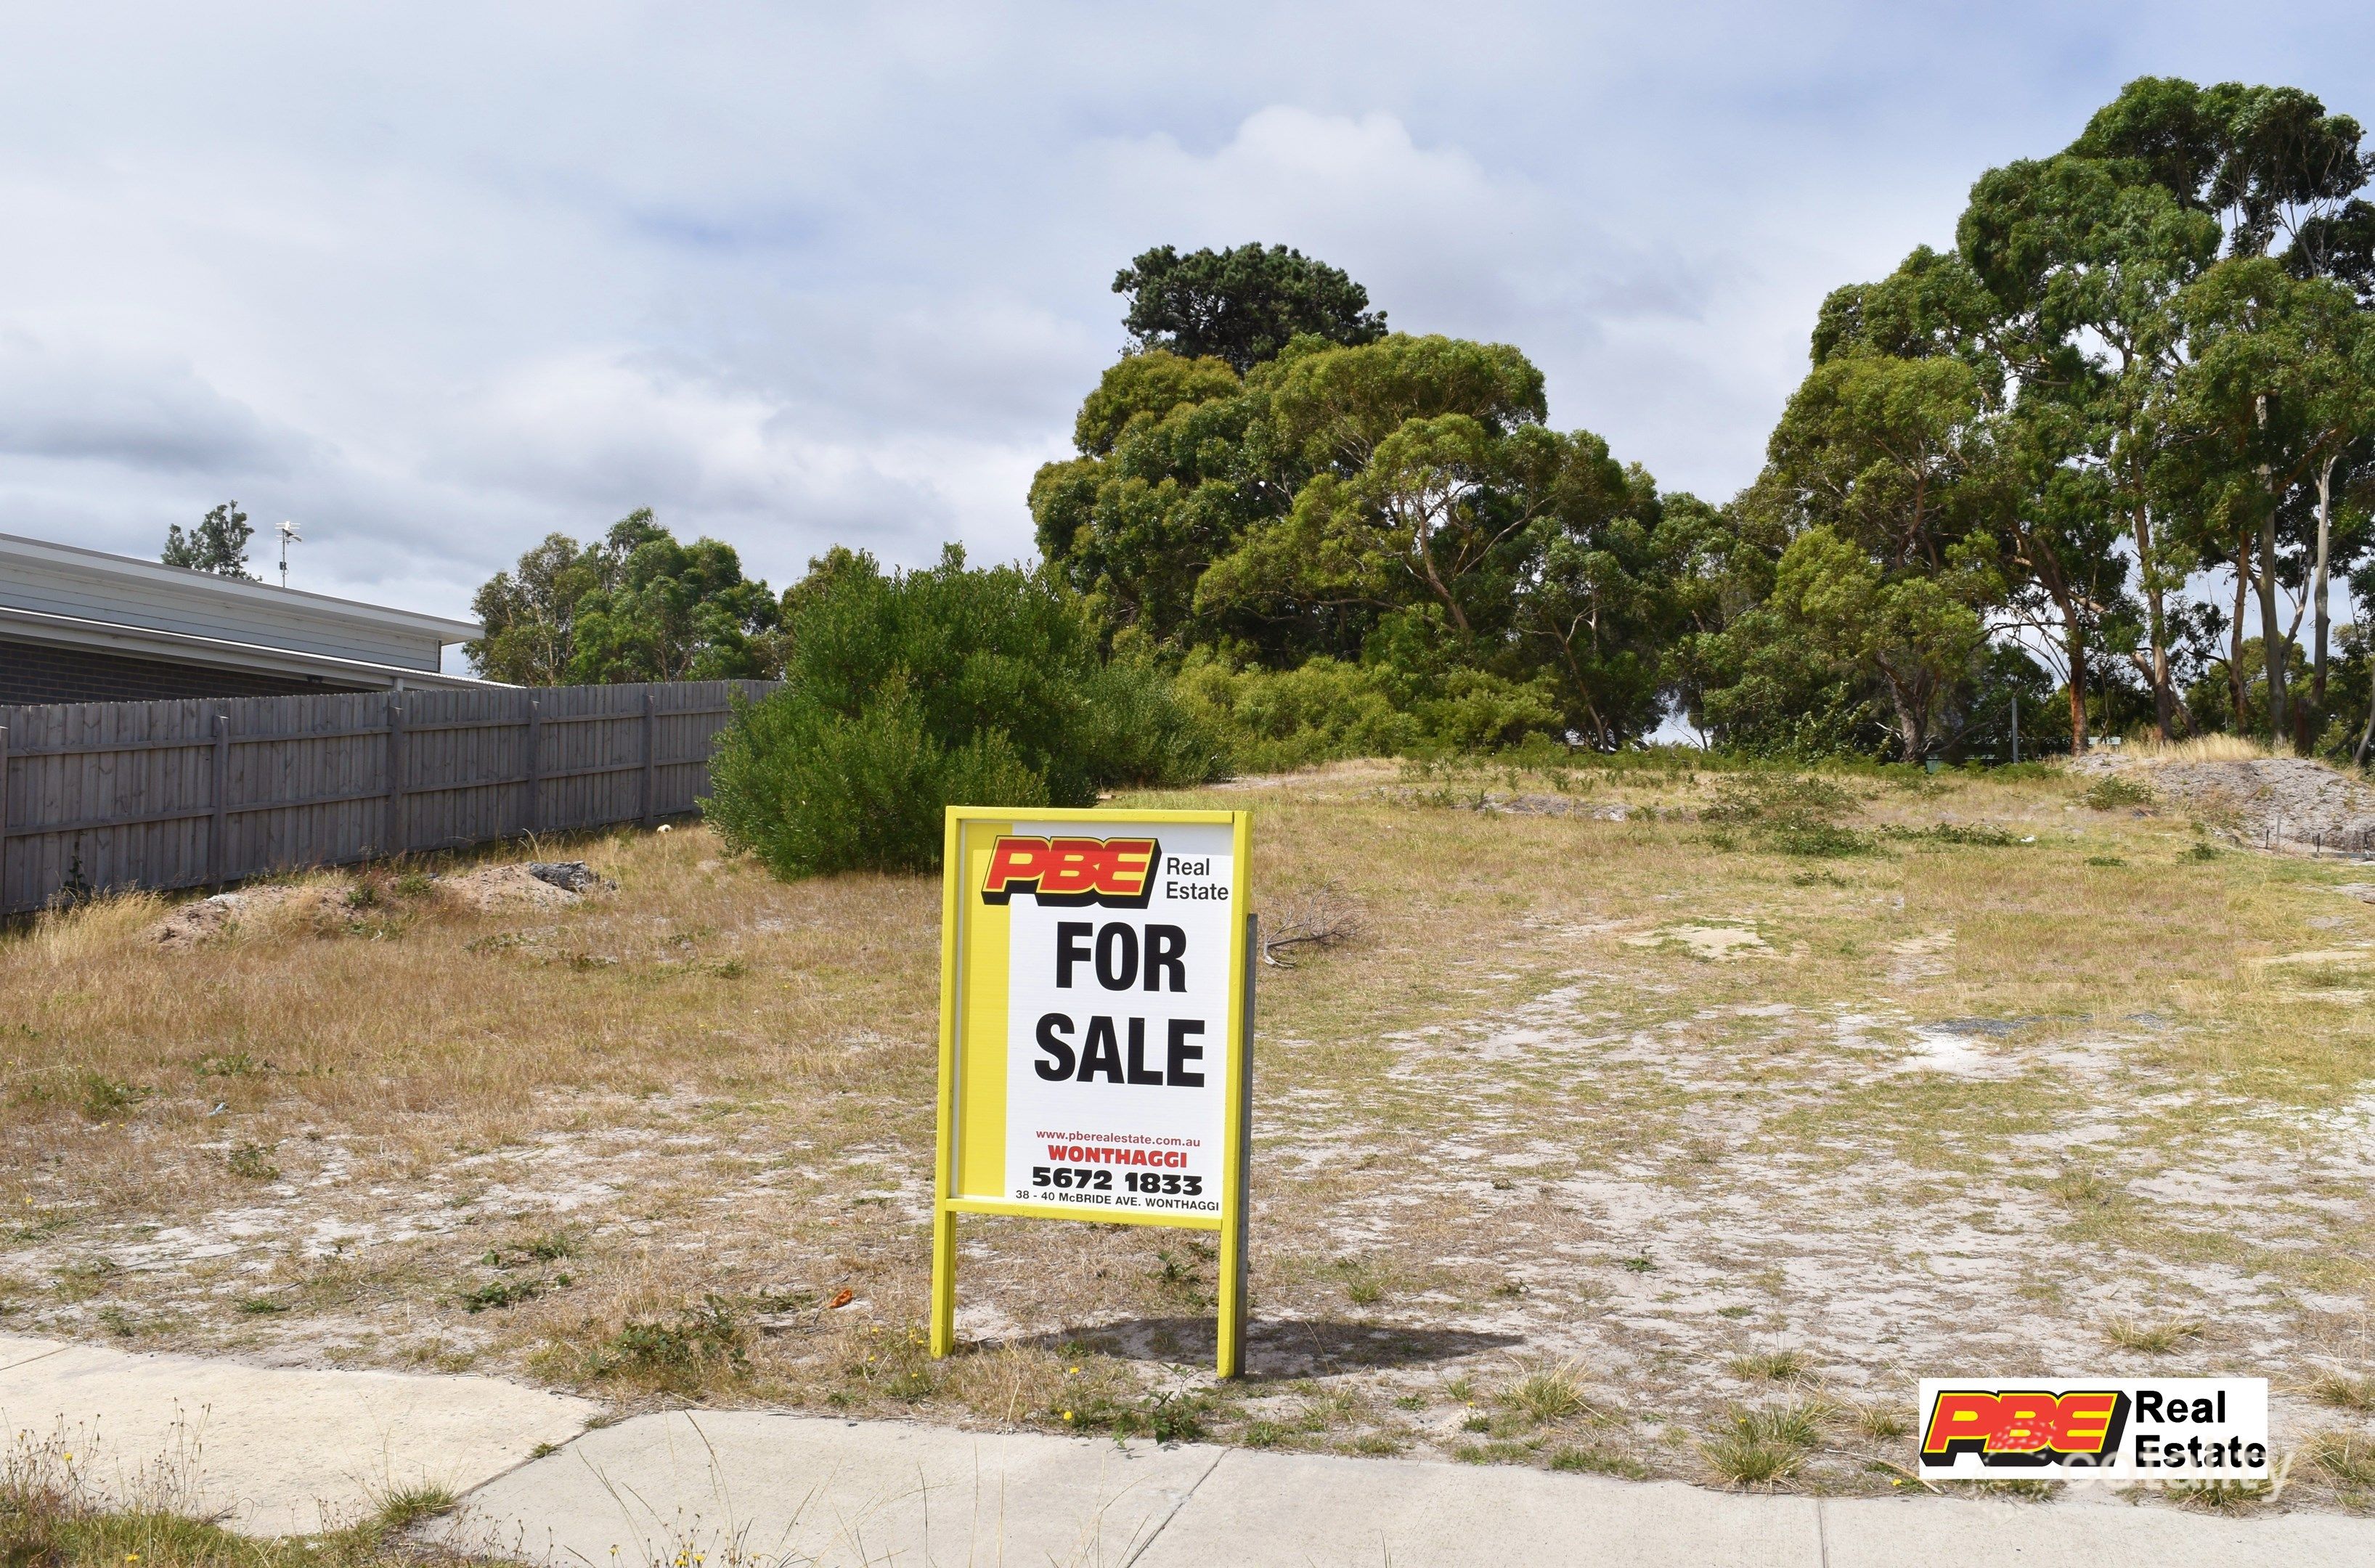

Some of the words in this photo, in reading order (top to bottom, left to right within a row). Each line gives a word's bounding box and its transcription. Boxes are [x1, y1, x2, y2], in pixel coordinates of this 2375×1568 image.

[982, 836, 1160, 906] PBE
[1166, 857, 1210, 876] Real
[1165, 881, 1229, 901] Estate
[1056, 921, 1188, 993] FOR
[1034, 1013, 1205, 1088] SALE
[1035, 1130, 1201, 1148] www.pberealestate.com.au
[1047, 1144, 1188, 1168] WONTHAGGI
[1032, 1166, 1113, 1191] 5672
[1124, 1172, 1203, 1196] 1833
[1015, 1190, 1030, 1200] 38
[1040, 1191, 1055, 1201] 40
[1058, 1193, 1112, 1205] McBRIDE
[1115, 1197, 1141, 1206] AVE.
[1145, 1198, 1220, 1212] WONTHAGGI
